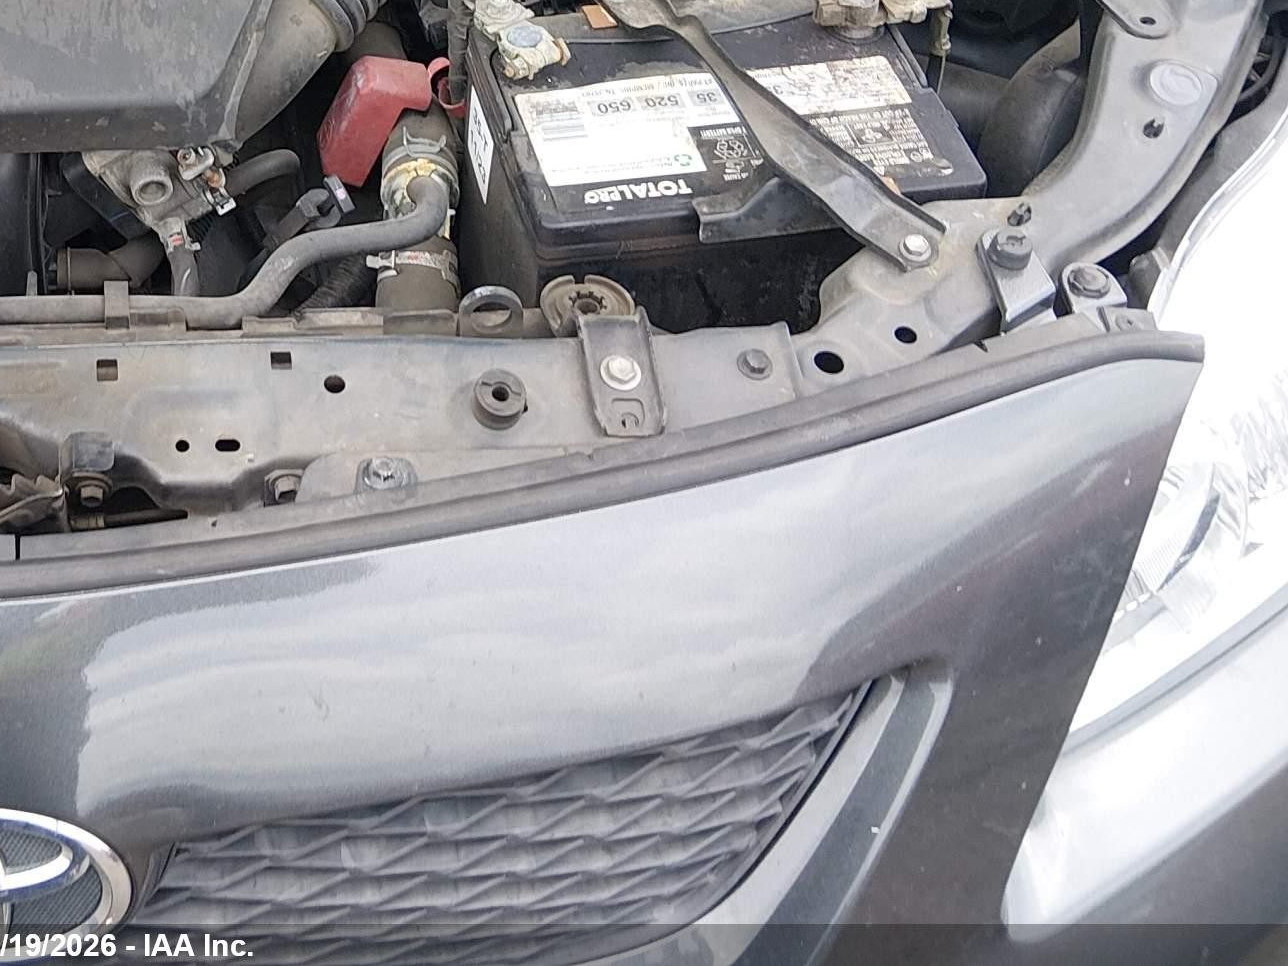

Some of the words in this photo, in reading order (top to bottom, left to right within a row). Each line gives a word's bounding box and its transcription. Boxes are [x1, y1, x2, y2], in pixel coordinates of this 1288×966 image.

[644, 94, 680, 108] 520
[696, 91, 718, 103] 35
[597, 100, 632, 115] 650
[584, 178, 693, 204] TOTALPRO
